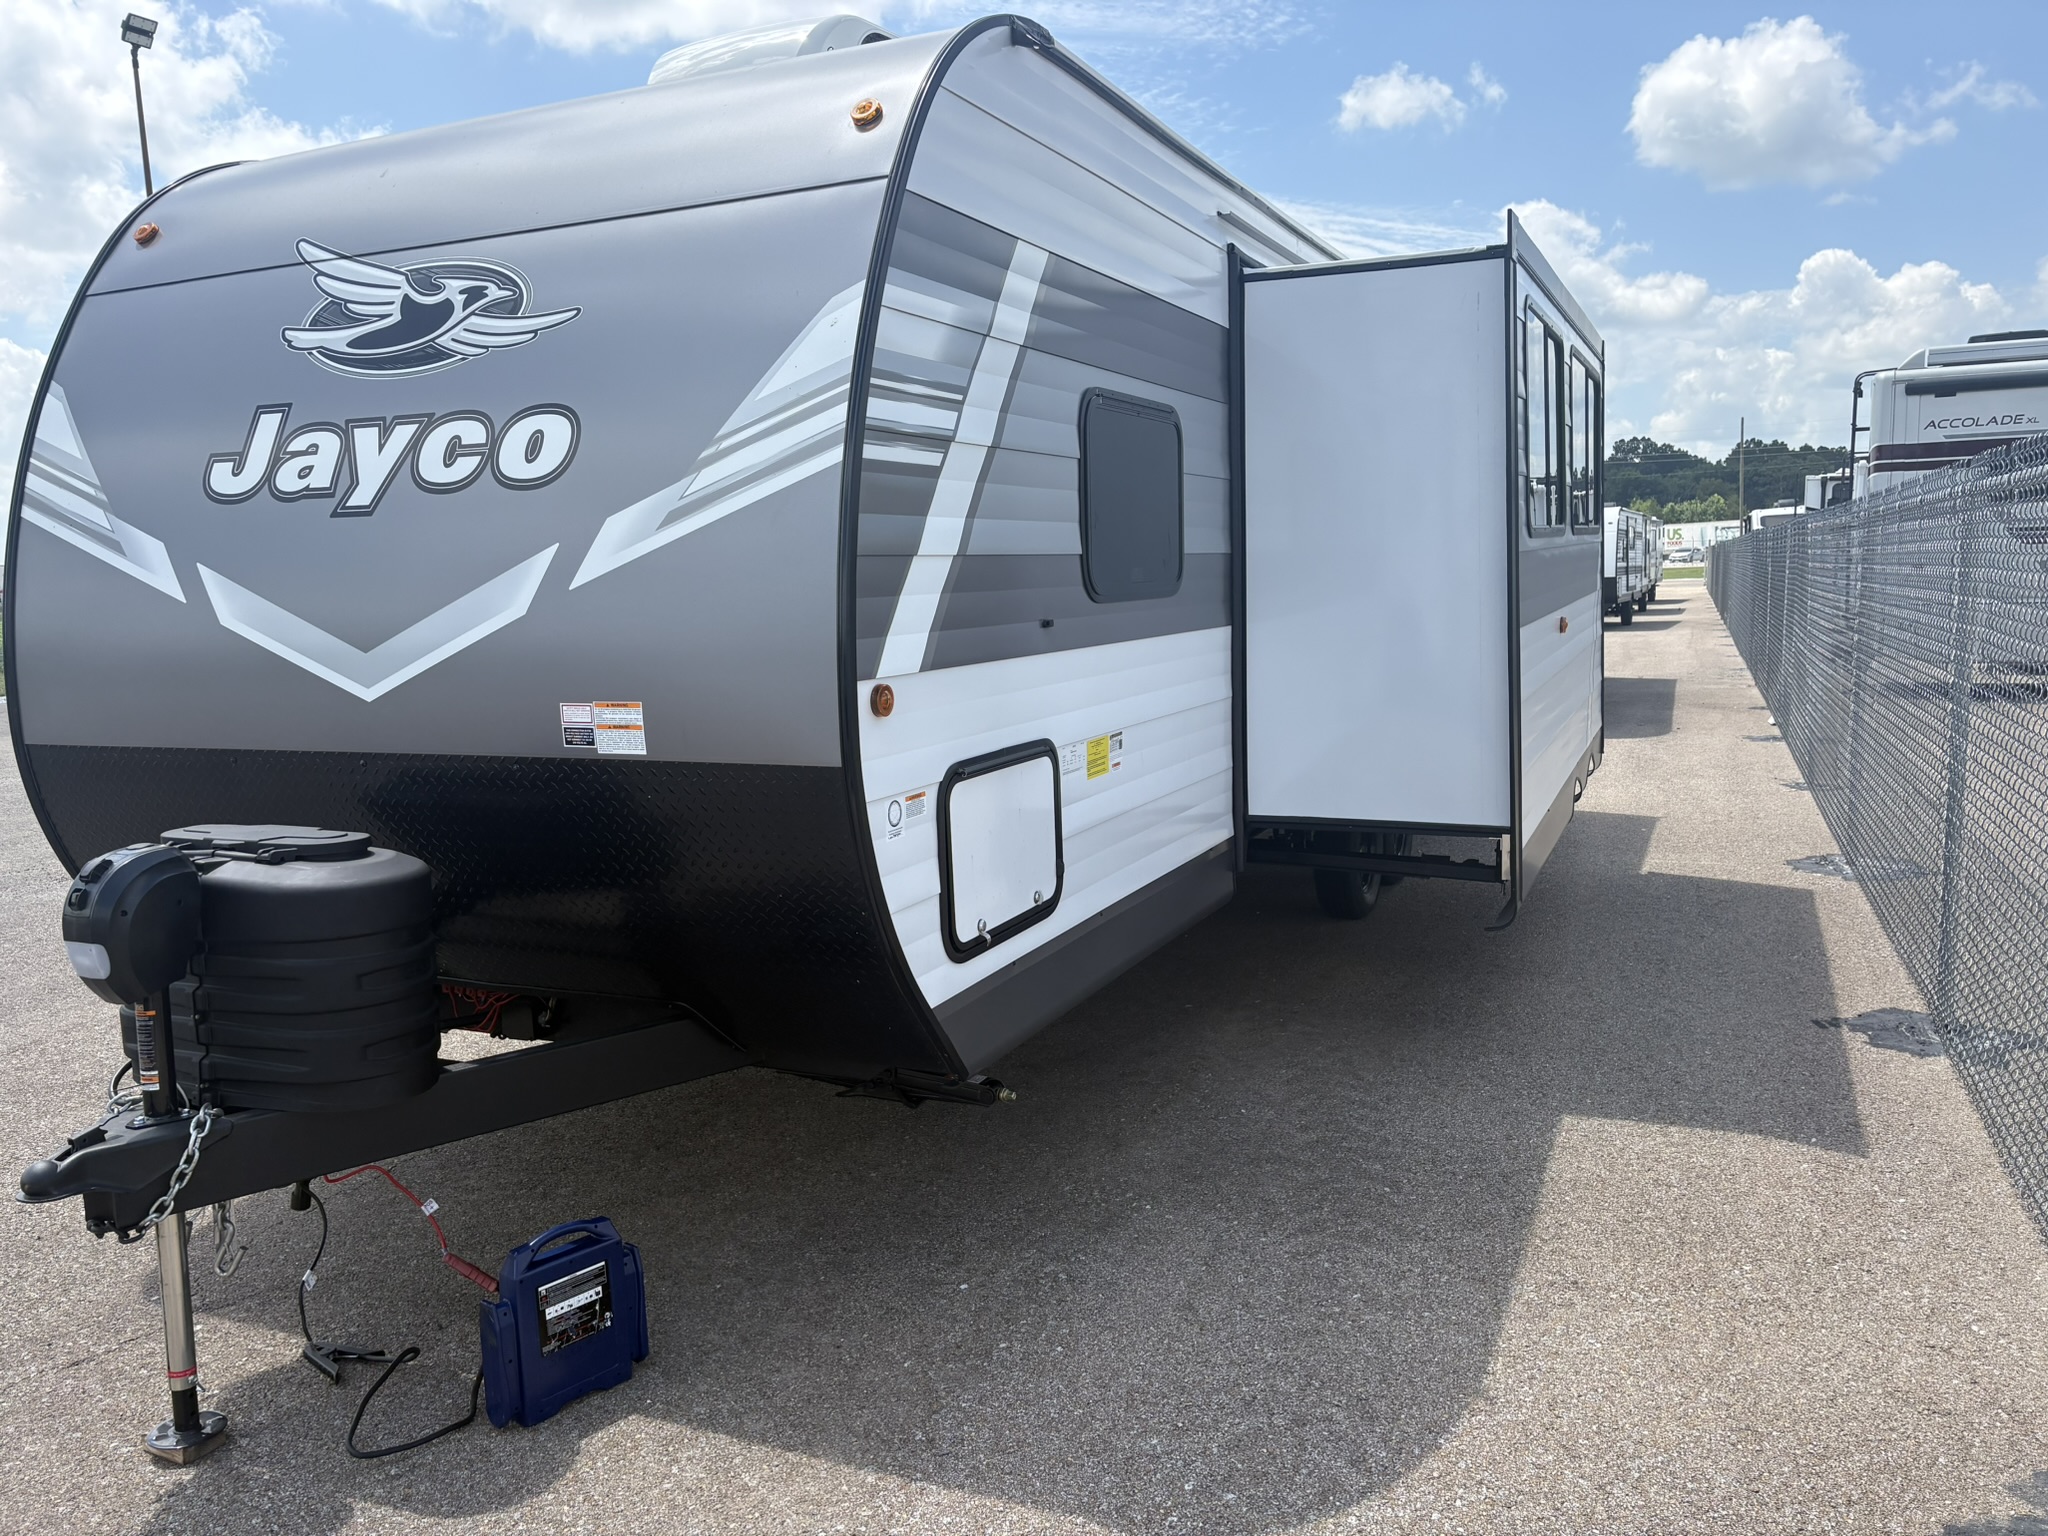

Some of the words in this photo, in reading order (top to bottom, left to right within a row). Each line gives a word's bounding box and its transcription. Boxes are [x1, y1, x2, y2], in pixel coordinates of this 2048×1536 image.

[1923, 414, 2025, 430] ACCOLADE
[2025, 416, 2040, 424] XL
[202, 402, 582, 518] Jayco
